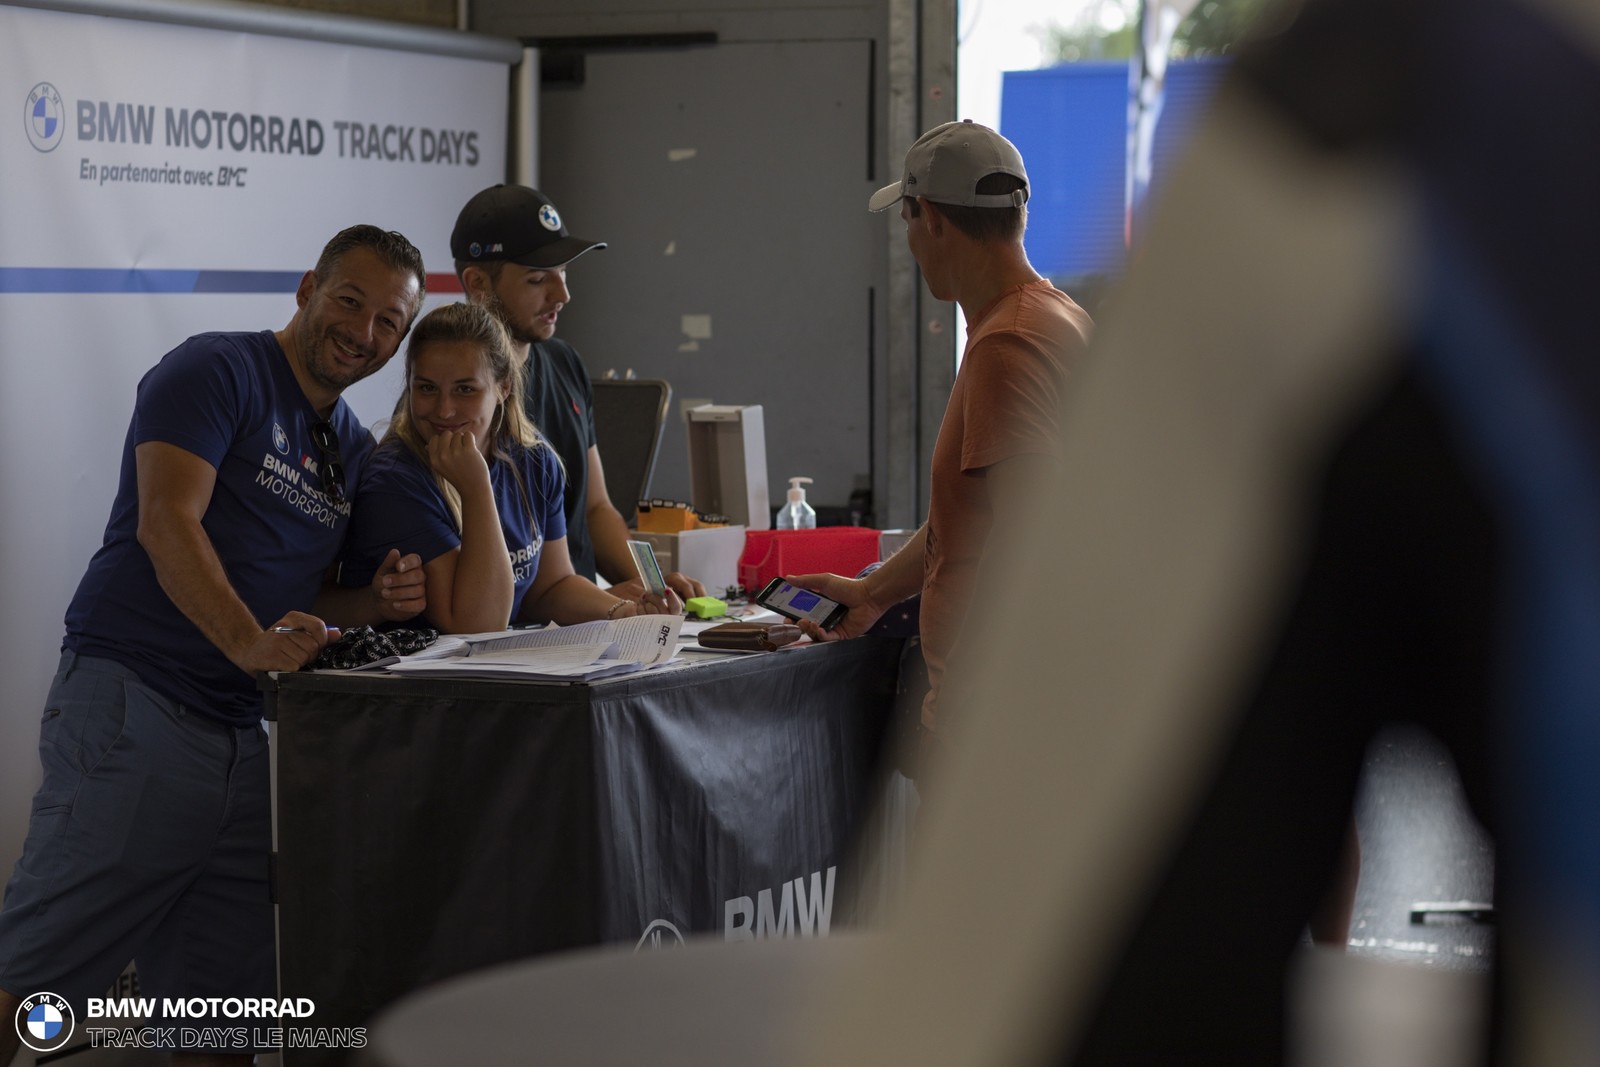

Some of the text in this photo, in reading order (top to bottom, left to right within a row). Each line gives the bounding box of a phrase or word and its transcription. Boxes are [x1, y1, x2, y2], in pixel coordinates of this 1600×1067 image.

[77, 99, 480, 167] BMW MOTORRAD TRACK DAYS
[79, 158, 248, 187] En partenariat avec BMC
[263, 453, 301, 485] BMW
[255, 470, 338, 529] MOTORSPORT
[508, 534, 544, 566] ORRAD
[513, 562, 532, 584] RT
[724, 865, 837, 943] BMW
